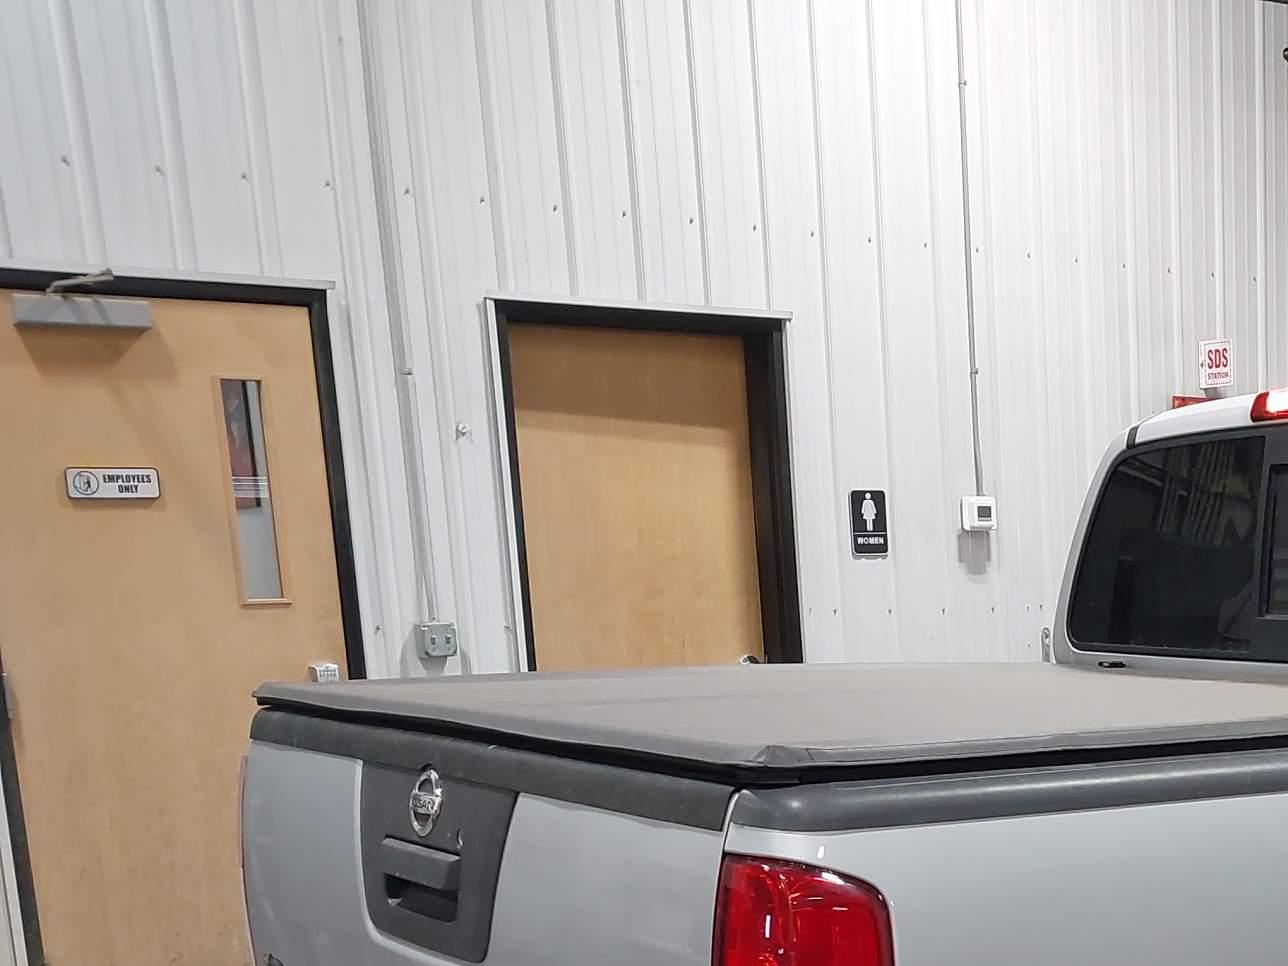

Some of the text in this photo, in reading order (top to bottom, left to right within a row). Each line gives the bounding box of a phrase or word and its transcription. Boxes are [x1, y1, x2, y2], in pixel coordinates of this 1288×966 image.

[1207, 347, 1229, 369] SDS
[1207, 371, 1229, 380] STATION
[102, 474, 152, 483] EMPLOYEES
[117, 484, 139, 494] ONLY
[856, 536, 885, 545] WOMEN
